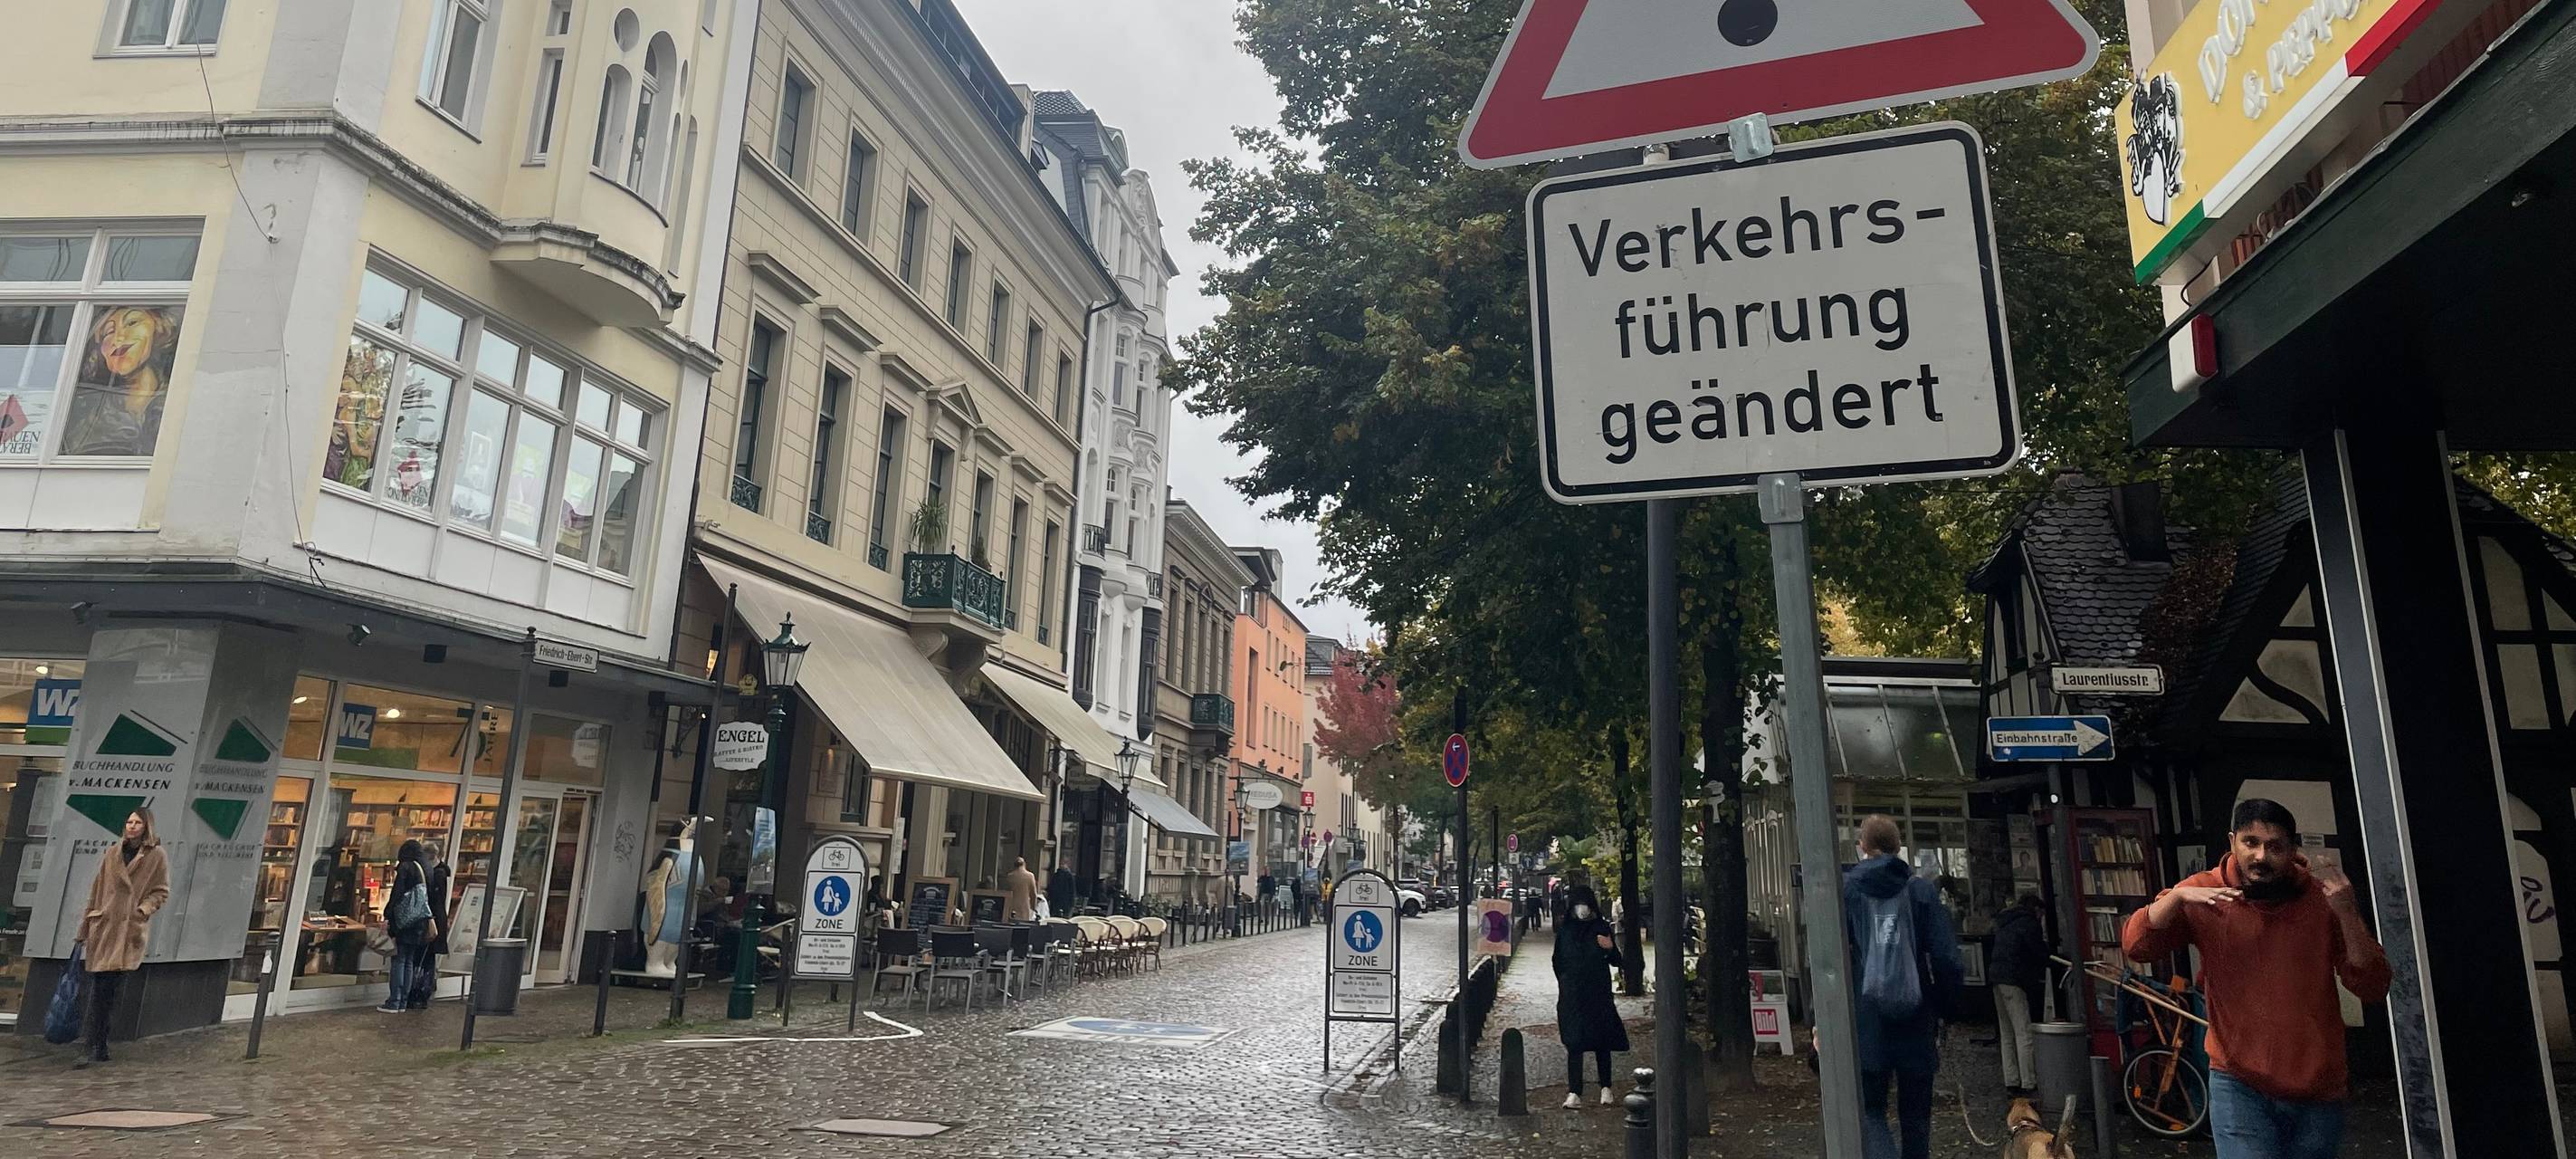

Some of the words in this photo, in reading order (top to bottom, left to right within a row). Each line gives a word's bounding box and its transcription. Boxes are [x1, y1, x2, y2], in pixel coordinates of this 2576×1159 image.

[2243, 70, 2268, 120] &
[1568, 196, 1945, 278] Verkehrs-
[1615, 286, 1910, 359] führung
[1601, 364, 1943, 465] geändert
[0, 442, 32, 454] BERA
[2062, 672, 2149, 686] Laurentiusstr.
[339, 712, 373, 740] WZ
[718, 729, 765, 742] ENGEL
[72, 760, 175, 773] BUCHHANDLUNG
[816, 918, 844, 930] ZONE
[1349, 954, 1379, 967] ZONE
